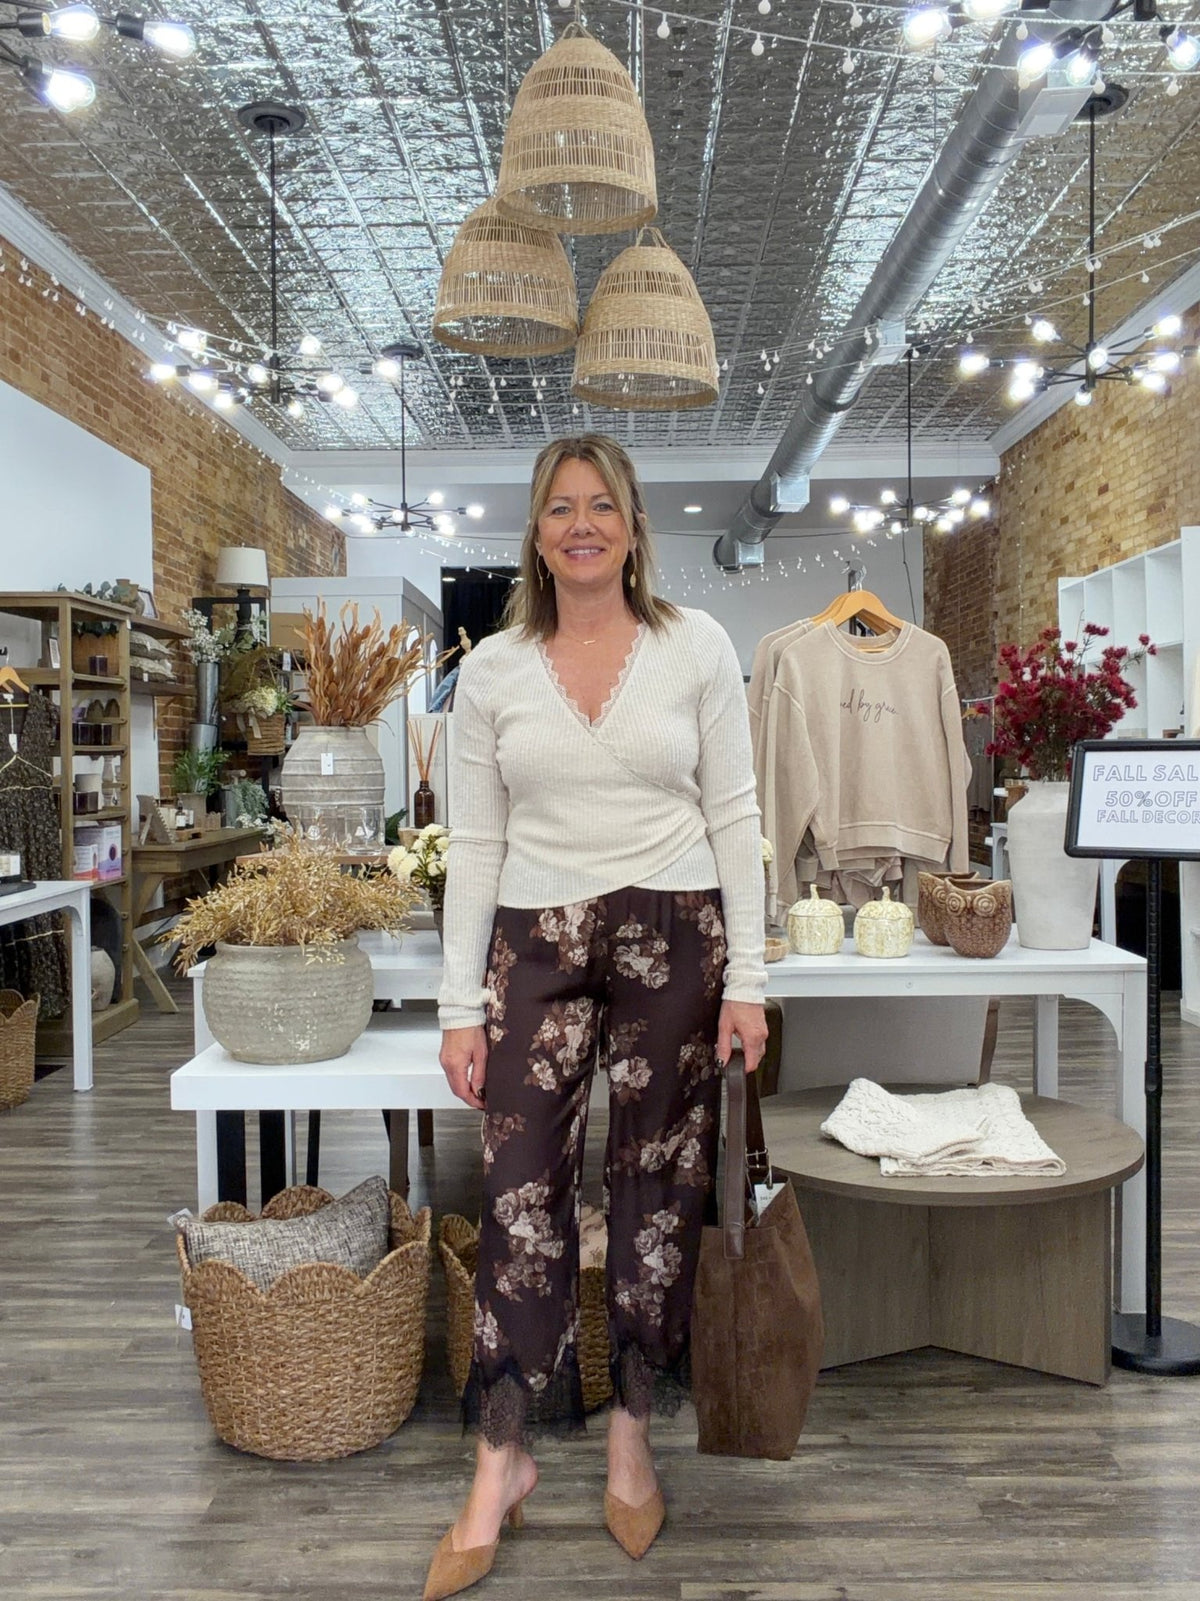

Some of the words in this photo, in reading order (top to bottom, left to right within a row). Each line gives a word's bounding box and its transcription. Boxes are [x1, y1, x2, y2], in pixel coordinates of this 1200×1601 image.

[840, 688, 855, 714] ed
[1093, 765, 1147, 781] FALL
[1153, 764, 1199, 781] SAL
[1097, 810, 1138, 823] FALL
[1142, 810, 1200, 824] DECOR
